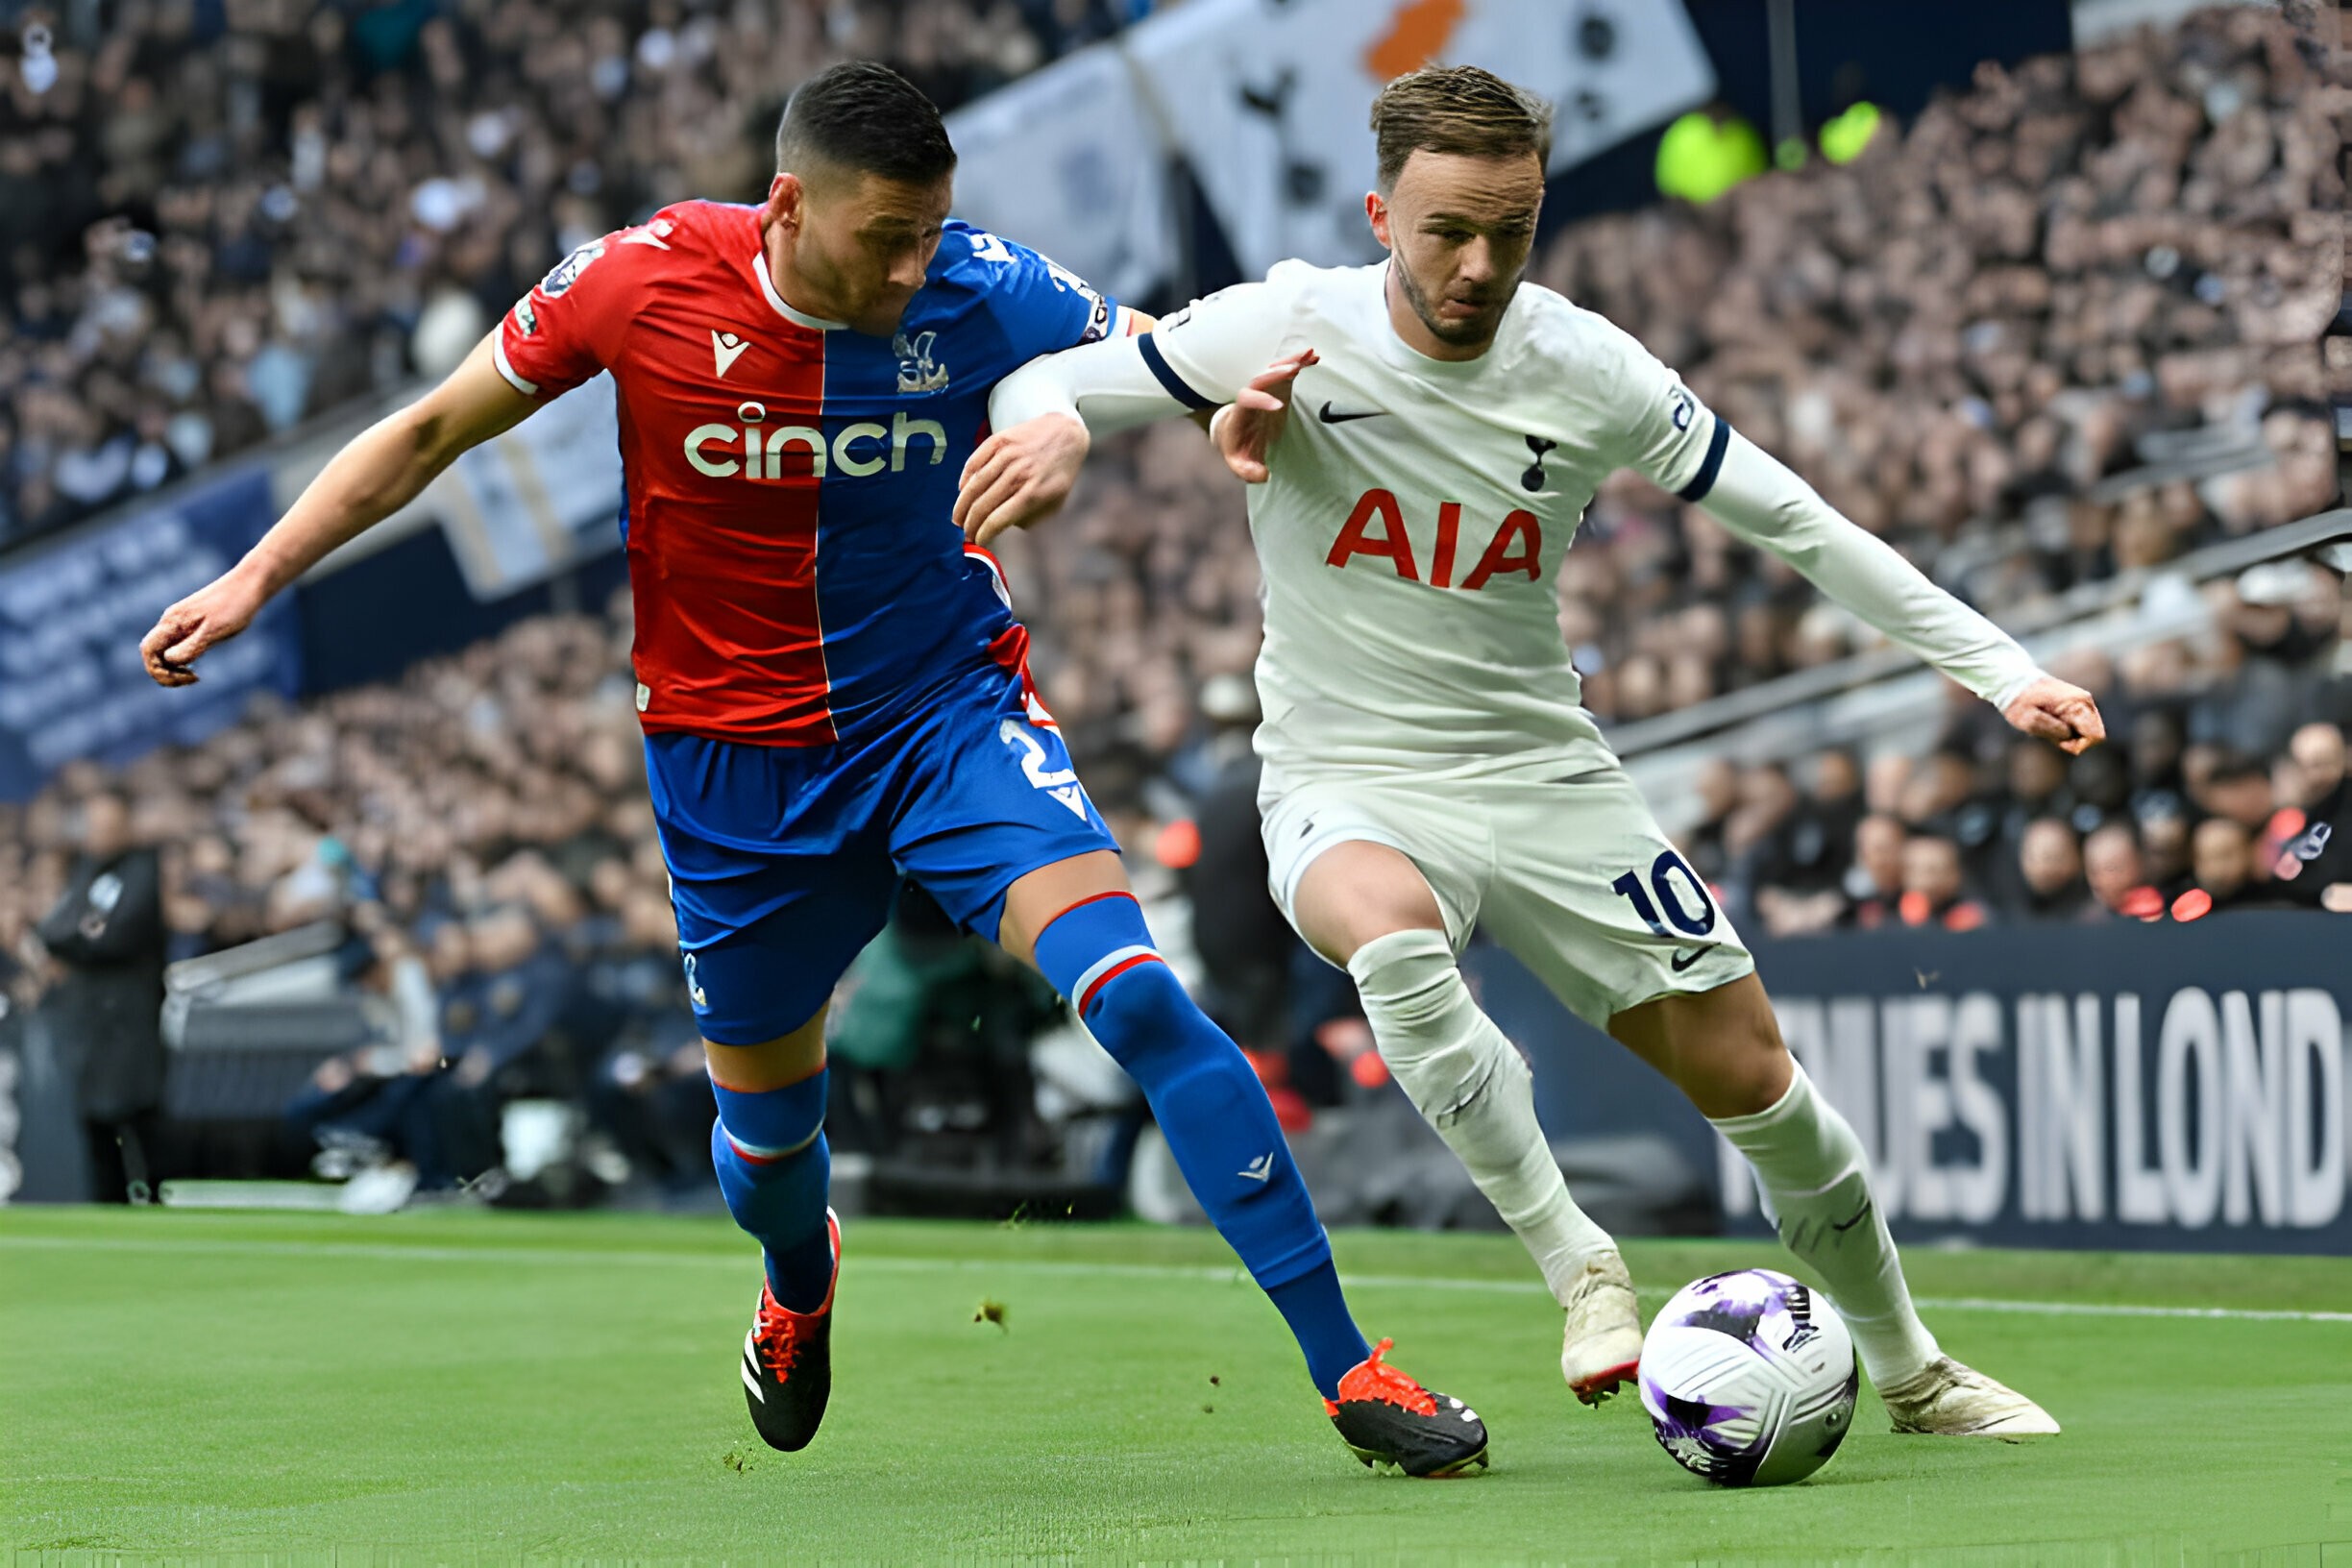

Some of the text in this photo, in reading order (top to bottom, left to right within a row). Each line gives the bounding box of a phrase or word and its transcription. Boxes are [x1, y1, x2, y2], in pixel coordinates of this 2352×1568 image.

[683, 401, 947, 479] cinch
[1326, 488, 1542, 591] AIA
[1611, 849, 1715, 939] 10
[2018, 992, 2104, 1223] IN
[2115, 986, 2352, 1229] LOND
